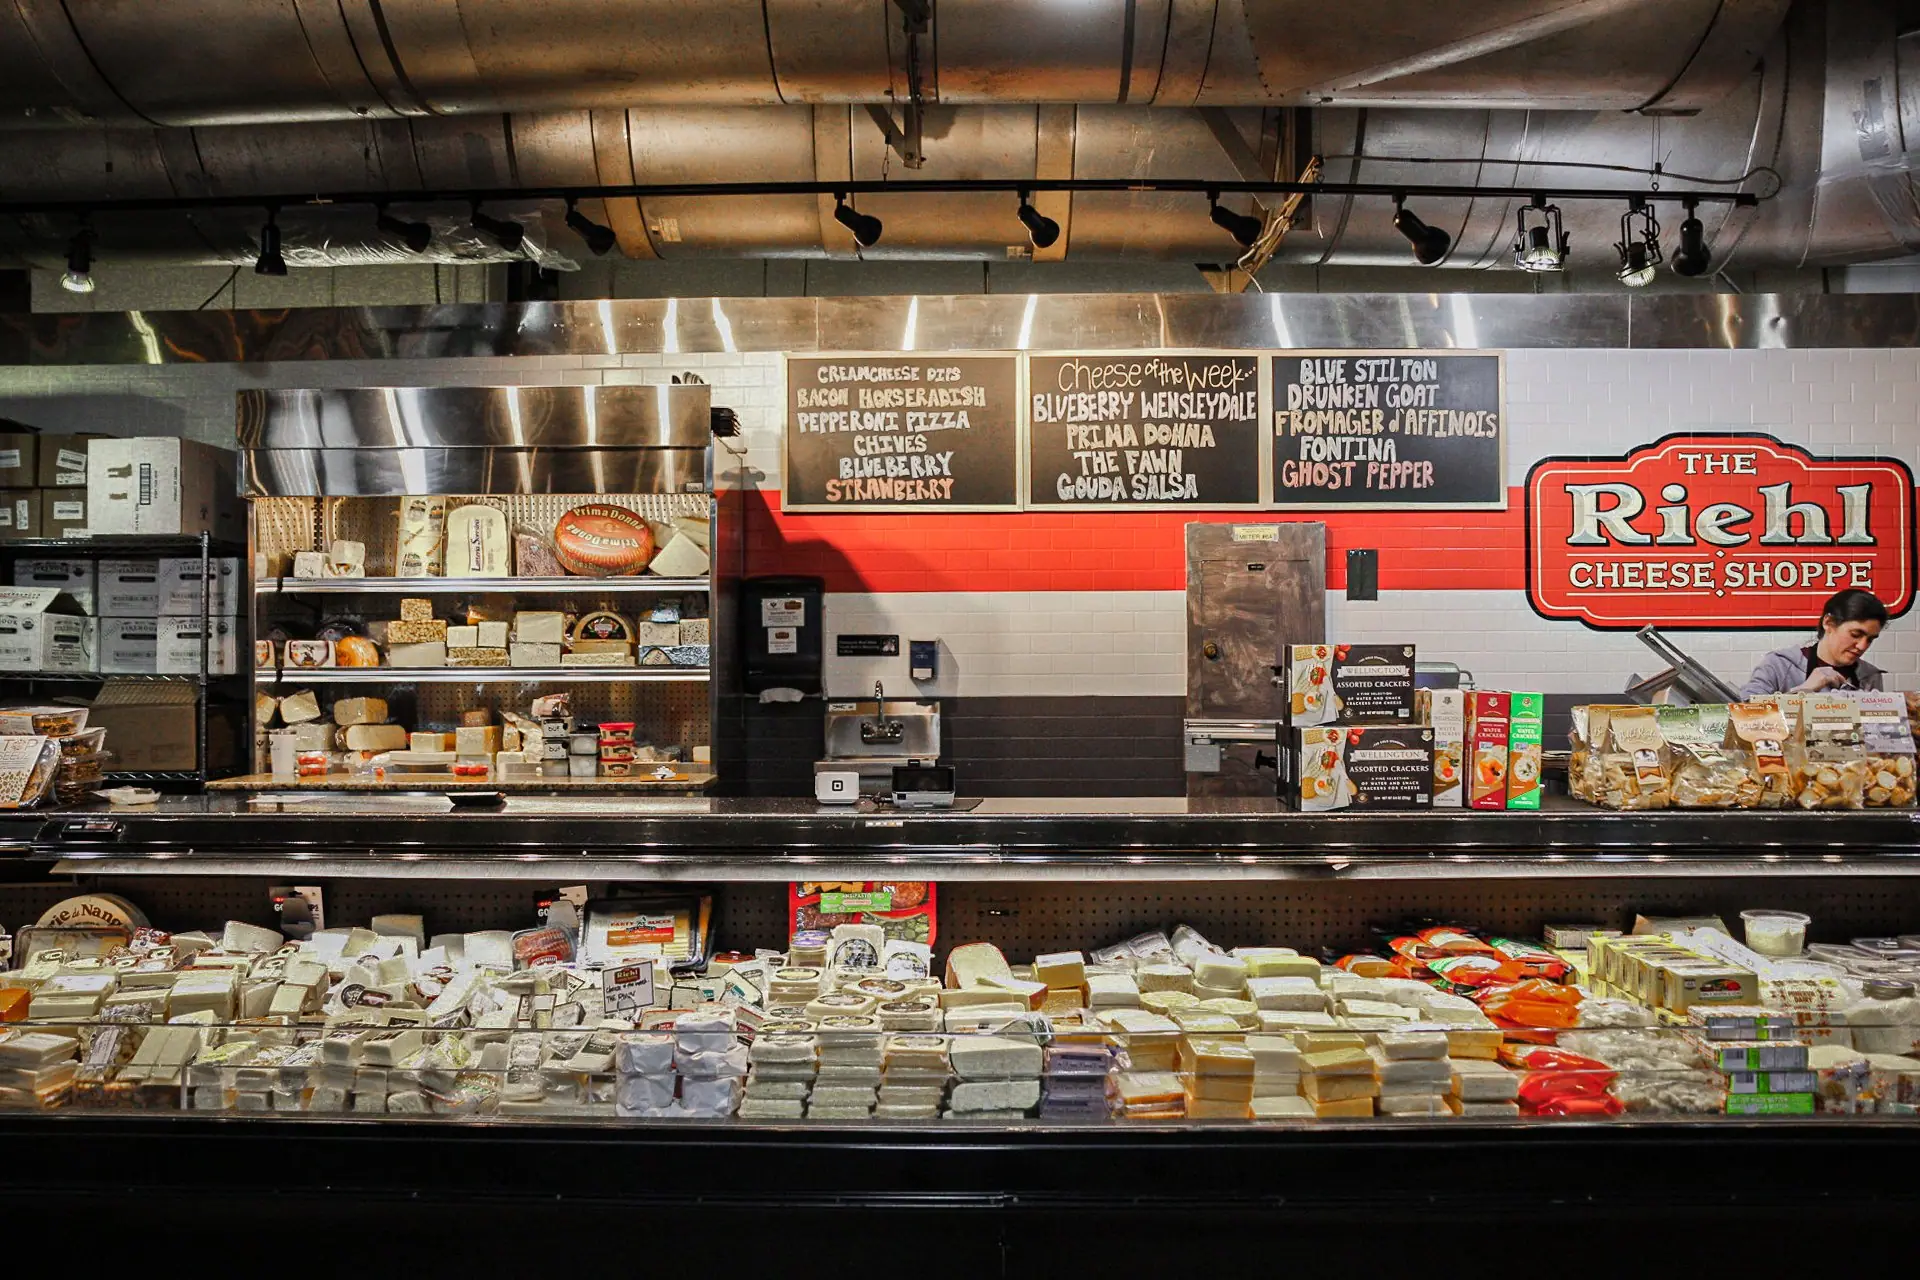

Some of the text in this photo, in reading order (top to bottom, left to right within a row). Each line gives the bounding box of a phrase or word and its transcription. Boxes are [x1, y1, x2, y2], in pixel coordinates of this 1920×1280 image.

[817, 366, 961, 382] CREAMCHEESE DIPS
[1058, 359, 1142, 392] Cheese
[1145, 358, 1160, 379] of
[1158, 362, 1184, 387] the
[1300, 358, 1438, 385] BLUE STILTON
[797, 386, 986, 408] BACON HORSERADISH
[1033, 391, 1257, 423] BLUEBERRY WENSLEYDALE
[1287, 384, 1440, 410] DRUNKEN GOAT
[797, 411, 970, 433] PEPPERONI PIZZA
[1275, 410, 1385, 437] FROMAGER
[853, 434, 927, 456] CHIVES
[1066, 424, 1216, 450] PRIMA DONNA
[1300, 436, 1396, 463] FONTINA
[839, 451, 954, 480] BLUEBERRY
[1073, 449, 1182, 477] THE FAWN
[1282, 461, 1435, 490] GHOST PEPPER
[1678, 451, 1757, 475] THE
[825, 478, 955, 502] STRAWBERRY
[1057, 472, 1198, 502] GOUDA SALSA
[573, 507, 645, 530] Prima Donna
[1564, 481, 1877, 547] Riehl
[565, 524, 640, 548] Prima Donna
[1568, 560, 1873, 589] CHEESE SHOPPE
[1346, 667, 1401, 675] WELLINGTON
[1374, 680, 1411, 688] CRACKERS
[1359, 751, 1420, 759] WELLINGTON
